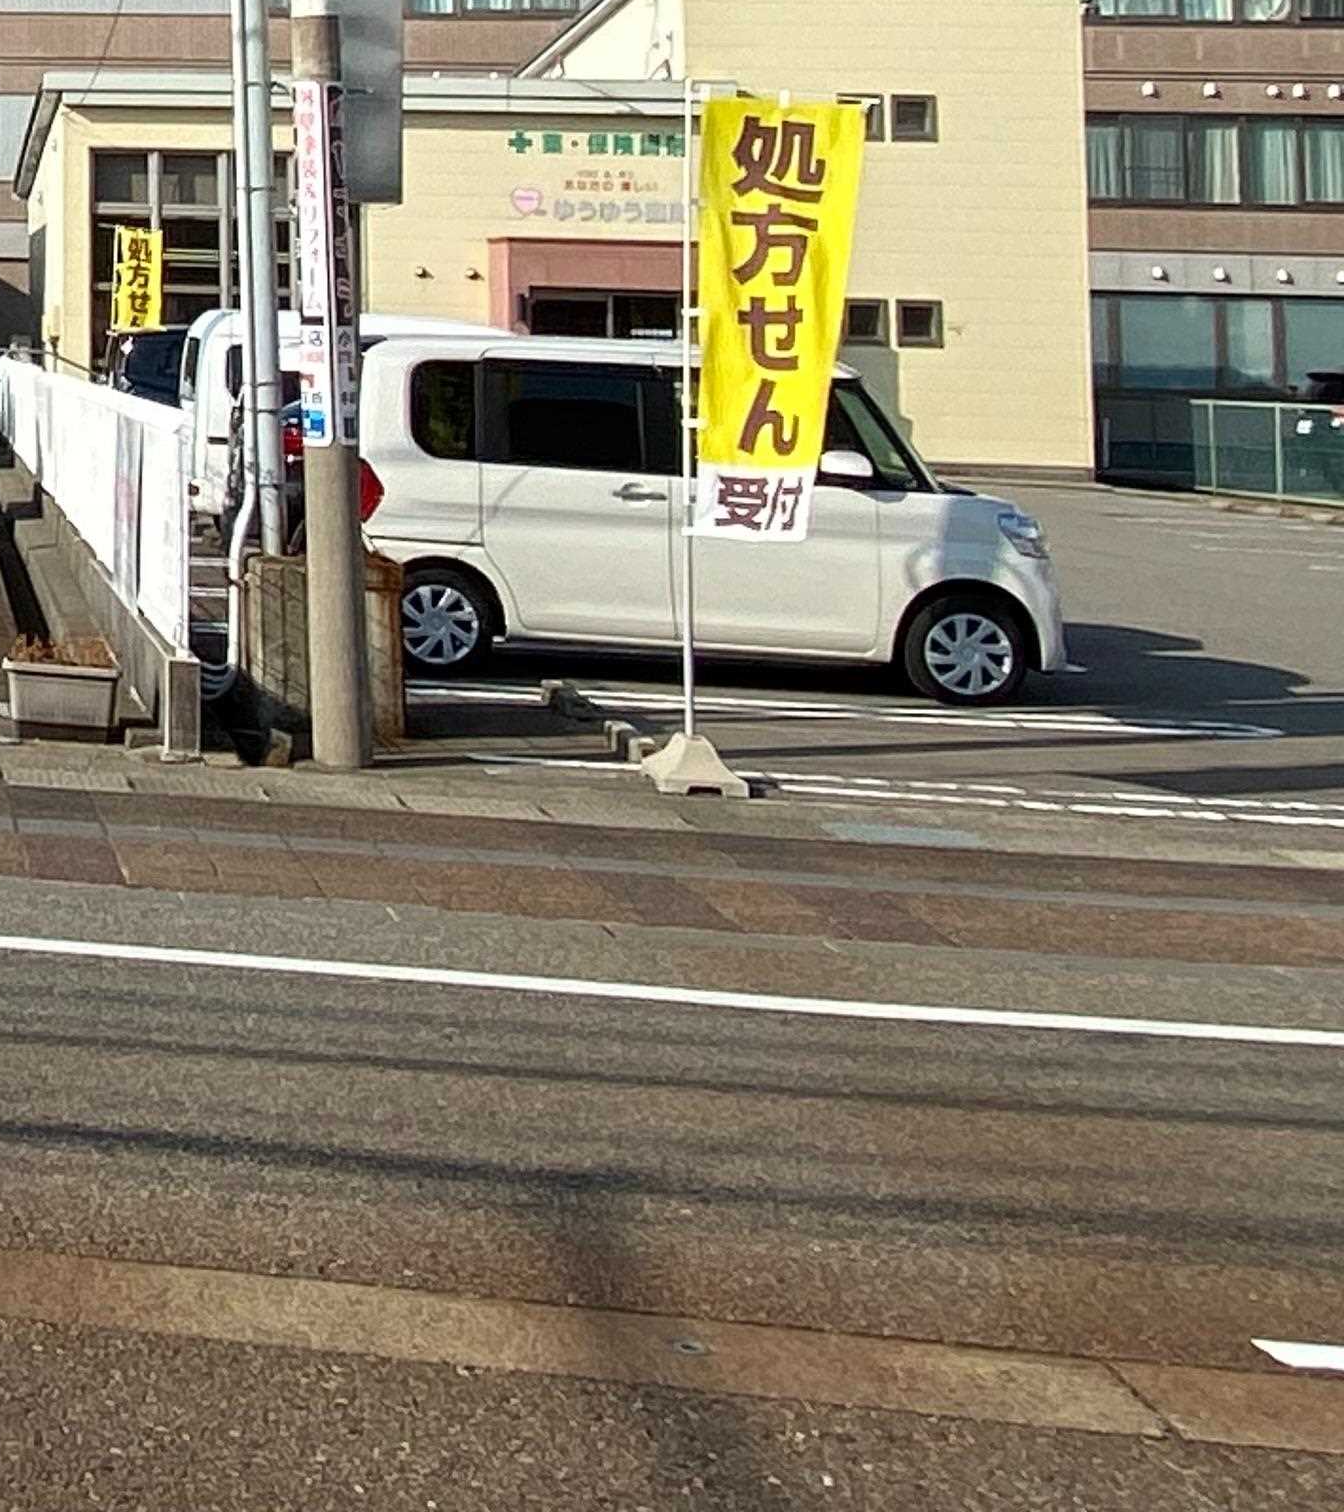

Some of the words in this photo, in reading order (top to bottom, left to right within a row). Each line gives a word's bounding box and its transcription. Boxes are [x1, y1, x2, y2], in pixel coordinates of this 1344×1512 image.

[731, 115, 826, 457] 処方せん
[714, 475, 805, 532] 受付
